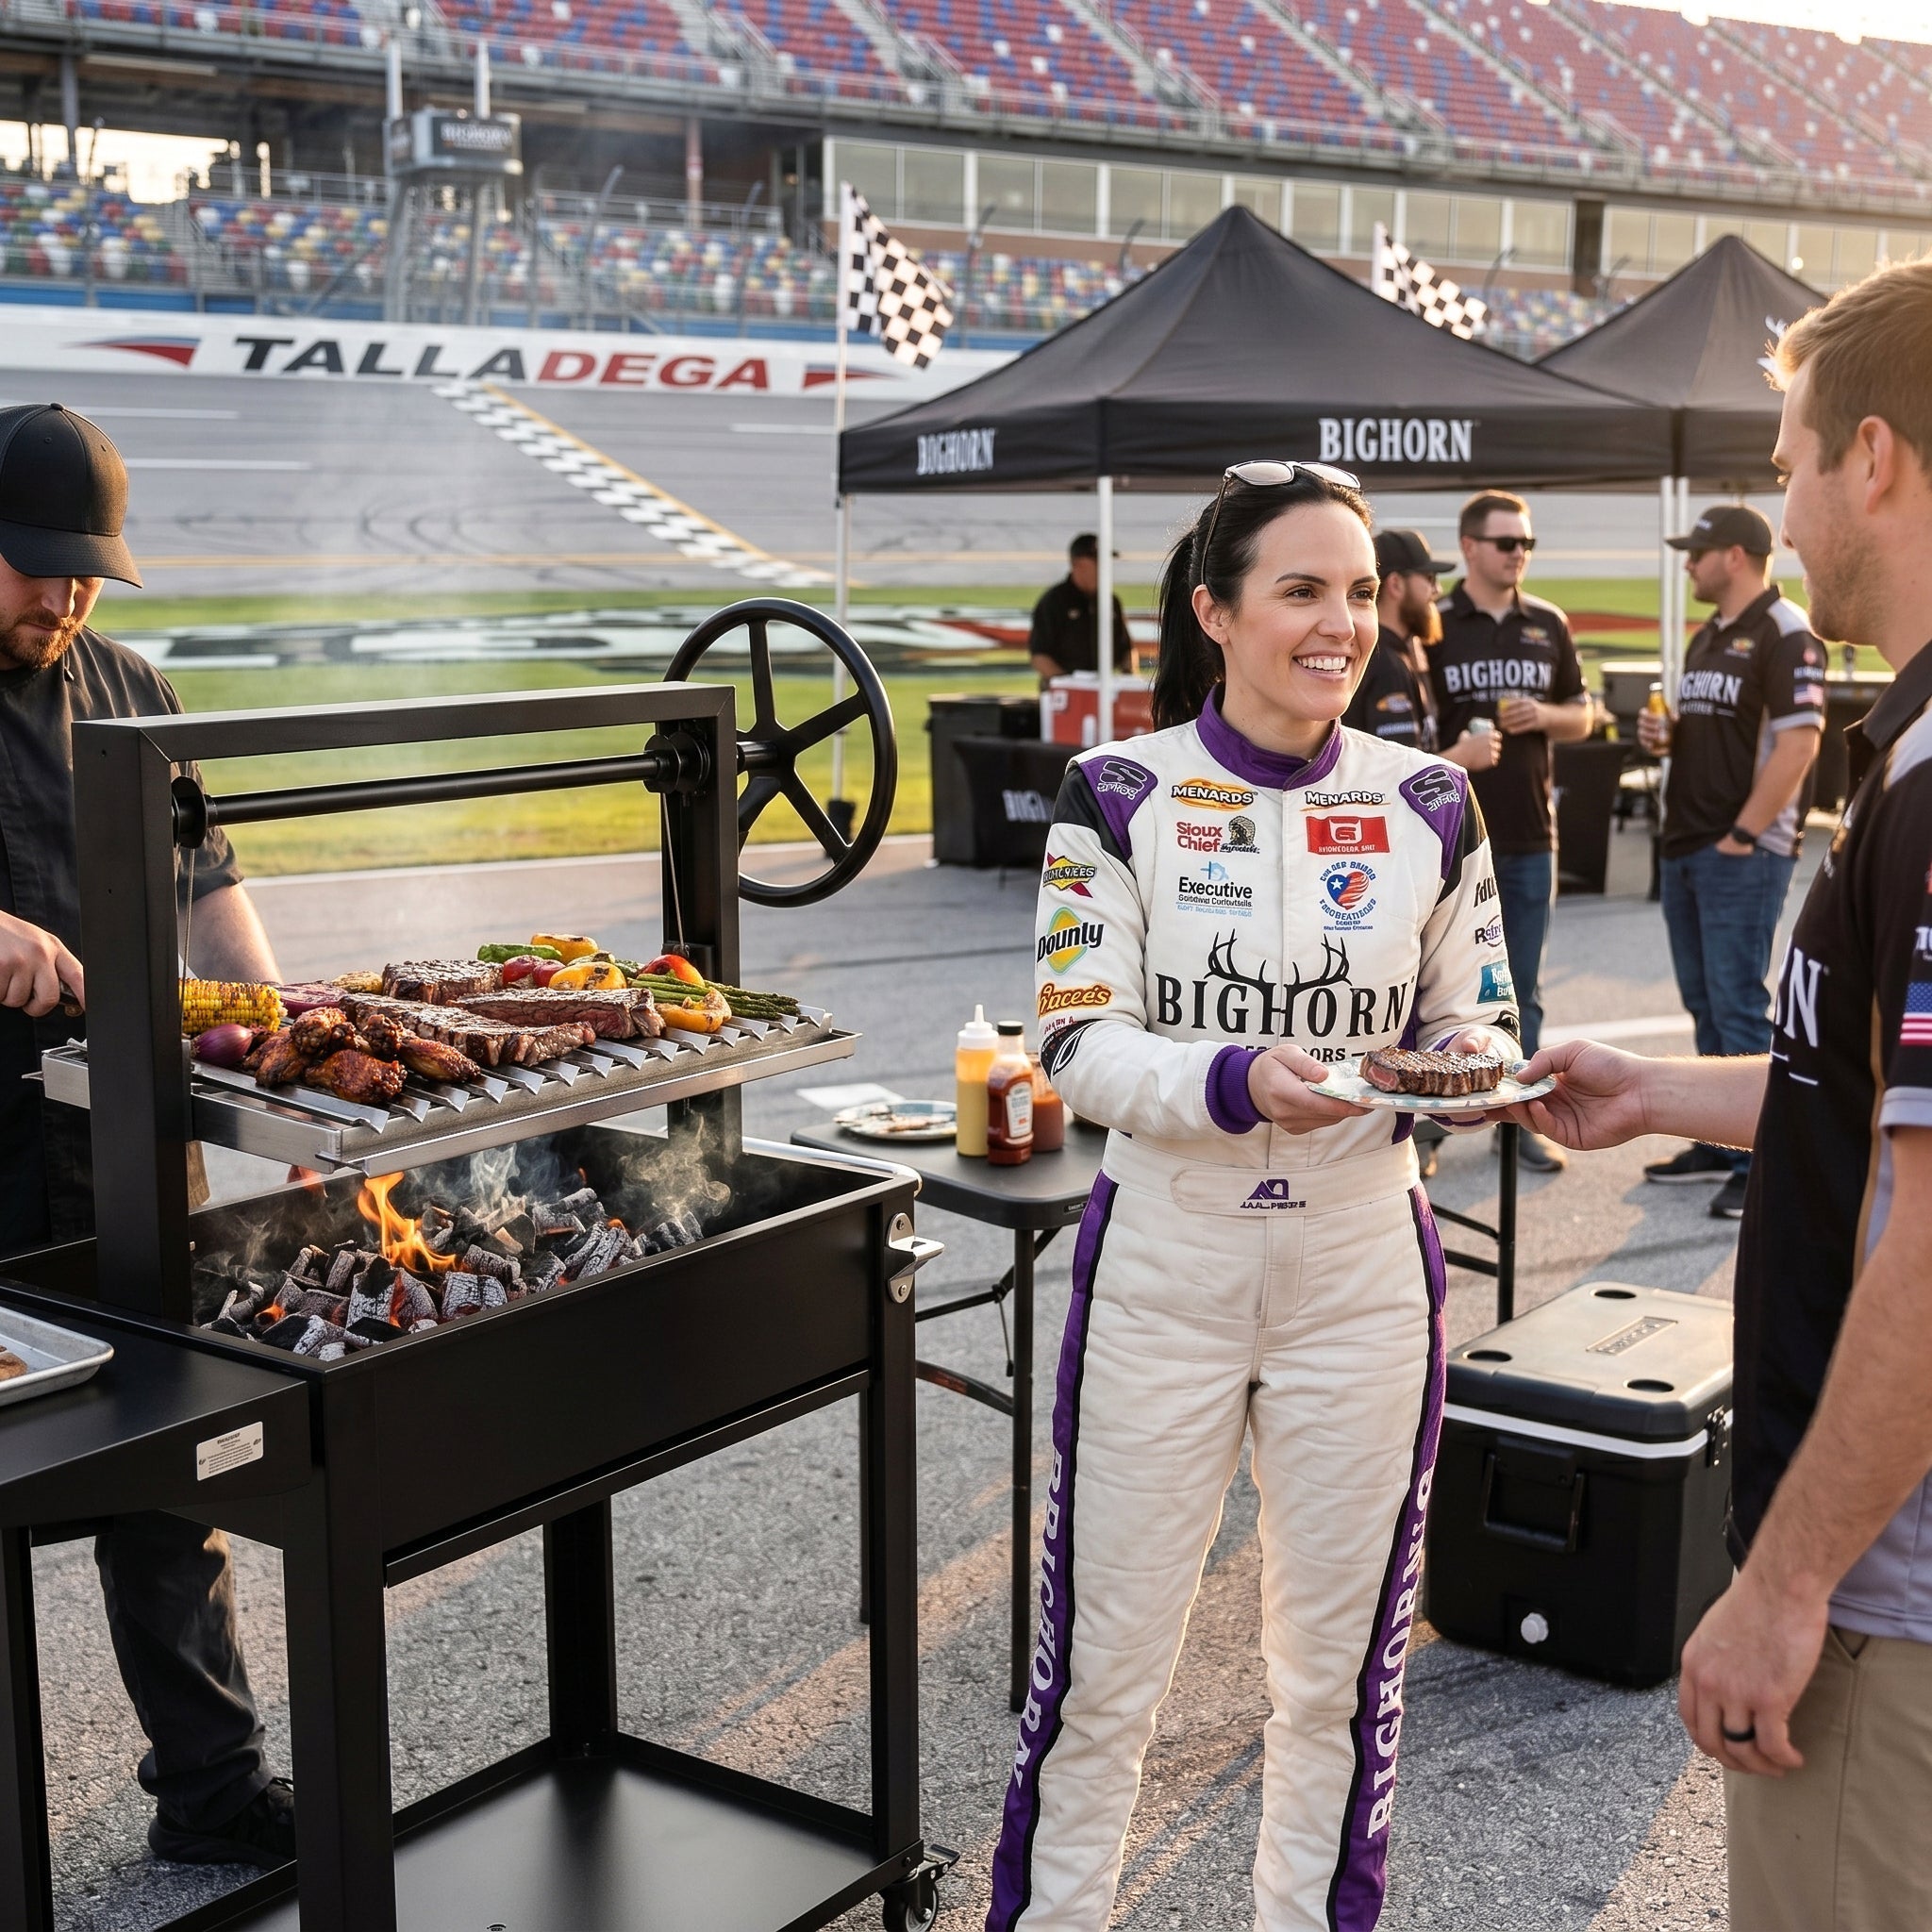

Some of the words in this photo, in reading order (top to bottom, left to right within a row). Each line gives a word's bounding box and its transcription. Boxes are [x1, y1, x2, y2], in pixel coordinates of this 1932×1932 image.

[235, 337, 769, 391] TALLADEGA
[1318, 418, 1474, 462] BIGHORN
[1443, 658, 1552, 693] BIGHORN
[1679, 669, 1742, 707] GHORN
[1171, 785, 1255, 806] MENARDS
[1305, 791, 1383, 807] MENARDS
[1176, 822, 1223, 838] Sioux
[1177, 835, 1221, 853] Chief
[1178, 876, 1253, 899] Executive
[1156, 973, 1407, 1038] BIGHORN
